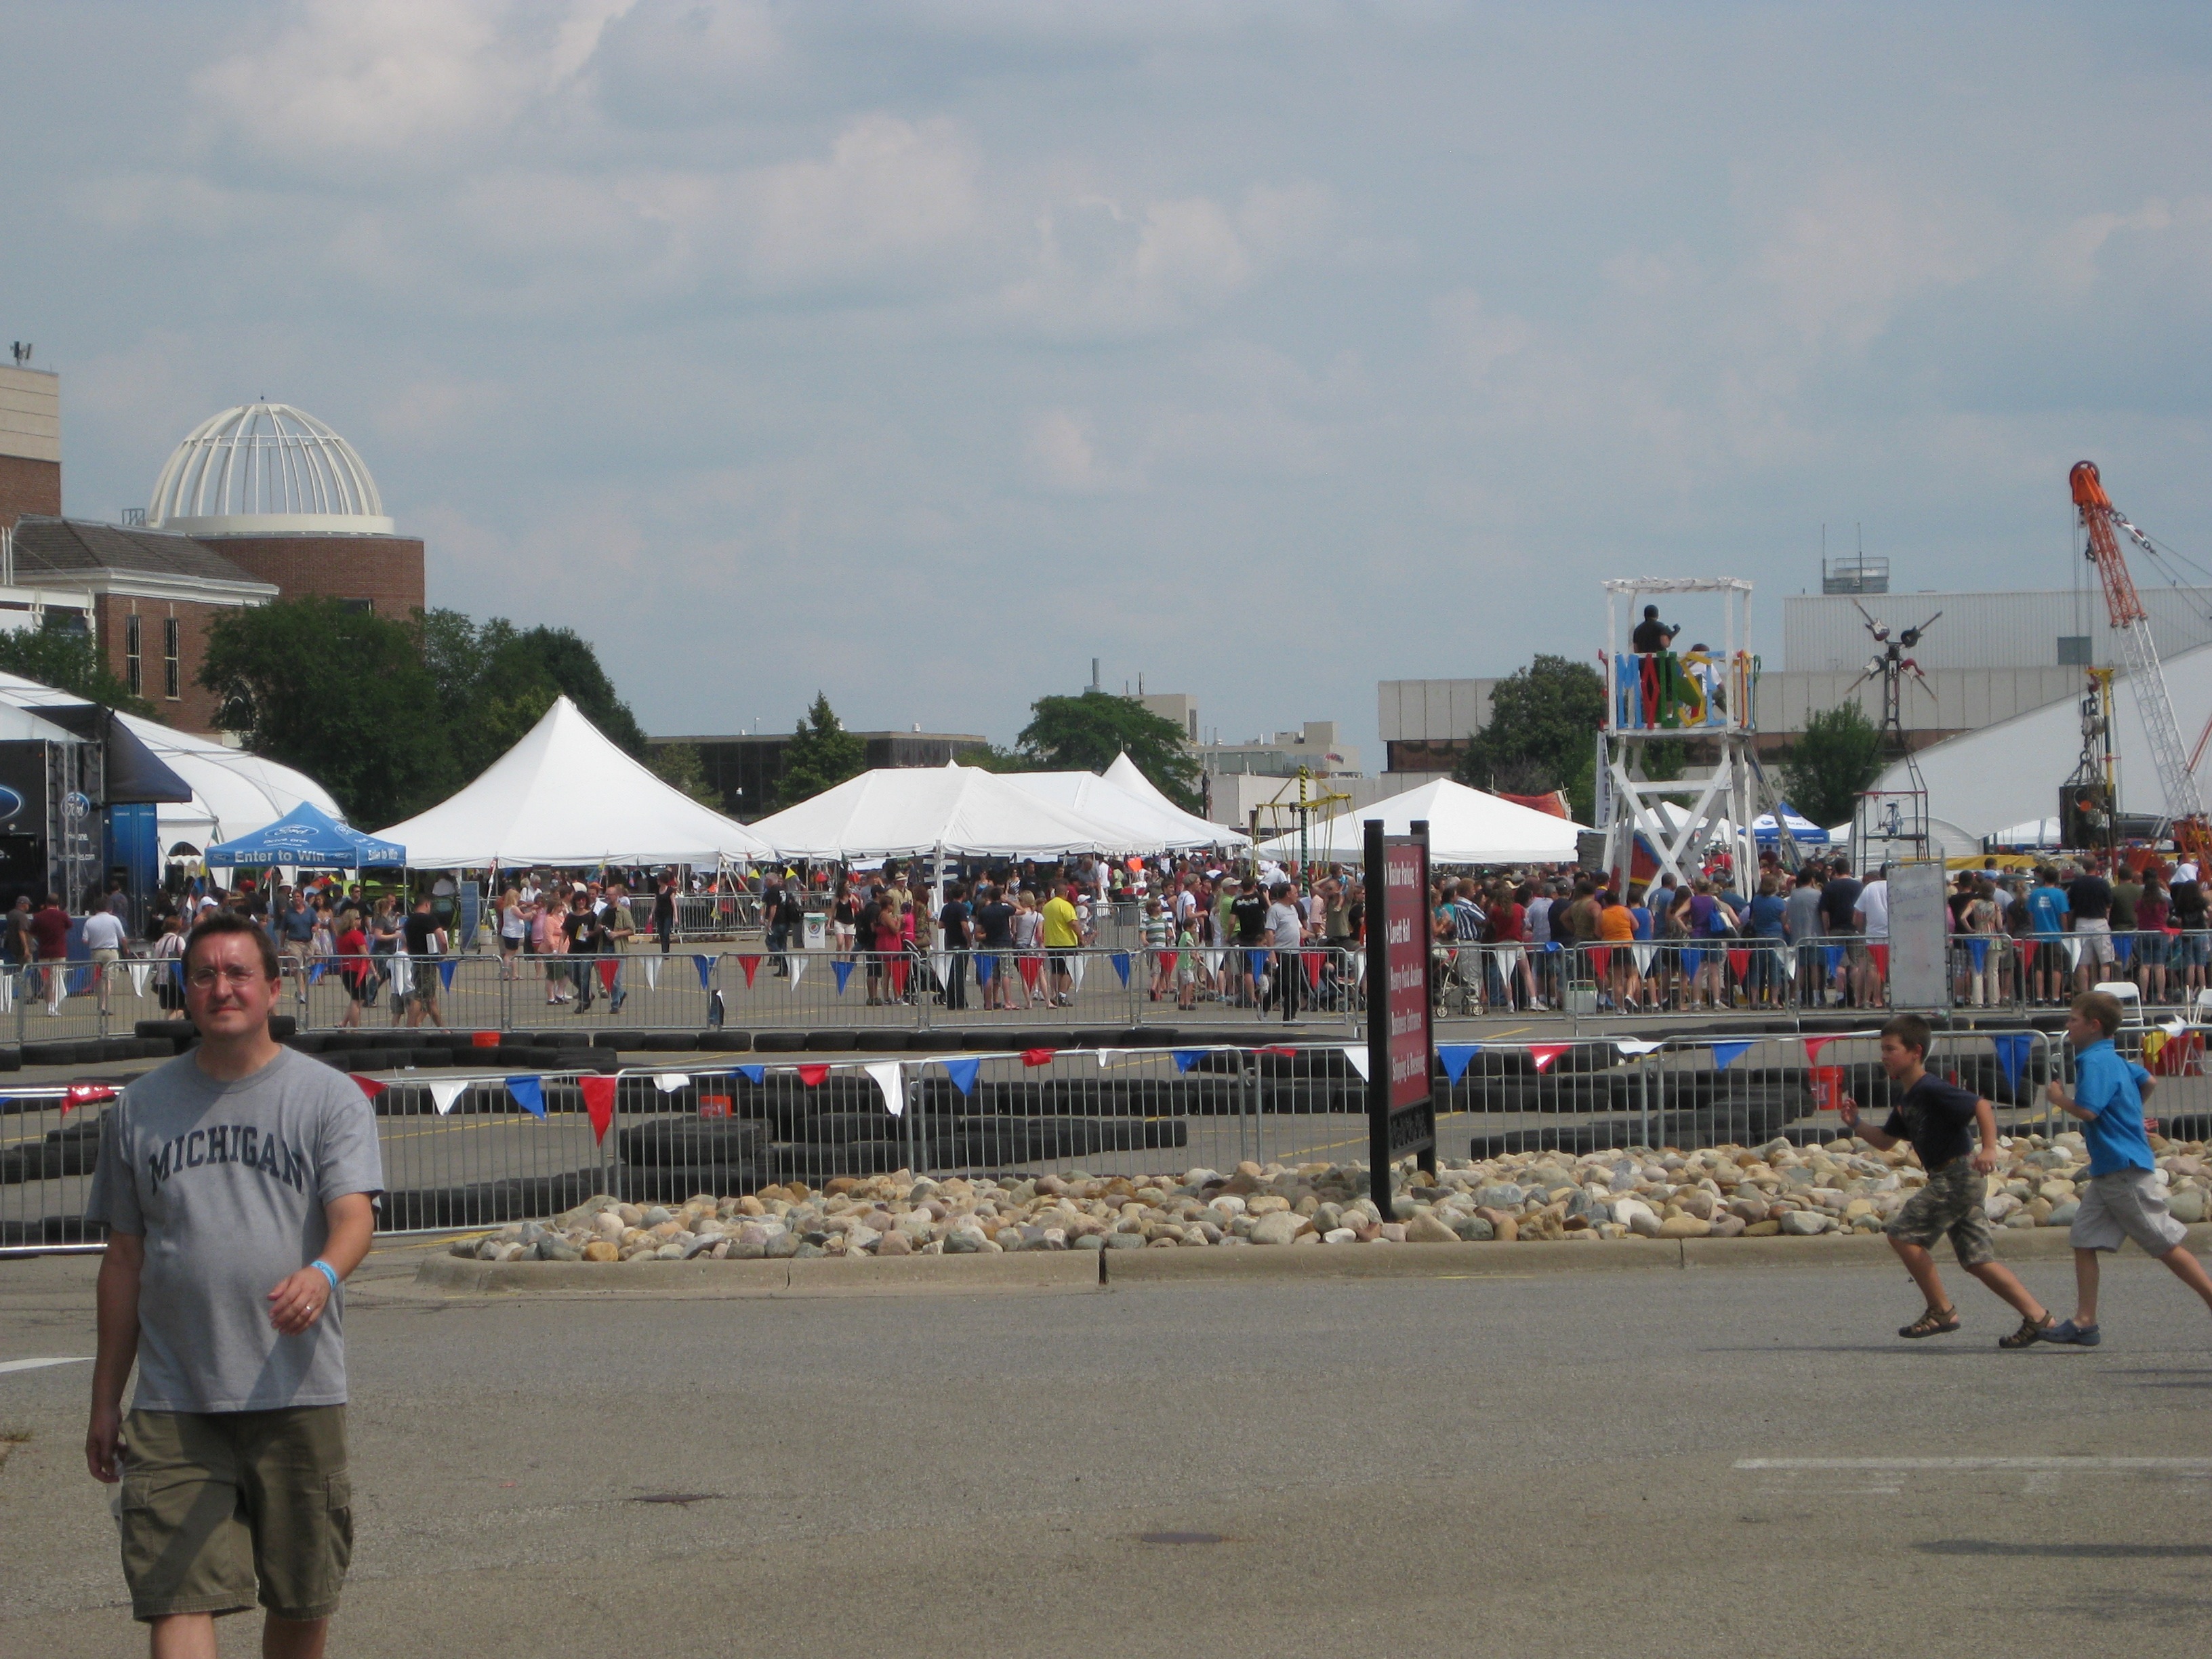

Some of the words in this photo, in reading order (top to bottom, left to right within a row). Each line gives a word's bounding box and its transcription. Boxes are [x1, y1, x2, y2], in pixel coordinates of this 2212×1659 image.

[234, 850, 272, 863] Enter
[278, 849, 292, 861] to
[297, 850, 325, 862] Win
[1389, 861, 1401, 886] Visitor
[1401, 860, 1414, 889] Parking
[1390, 919, 1402, 944] Lovett
[1391, 966, 1401, 994] Henry
[148, 1124, 305, 1196] MICHIGAN
